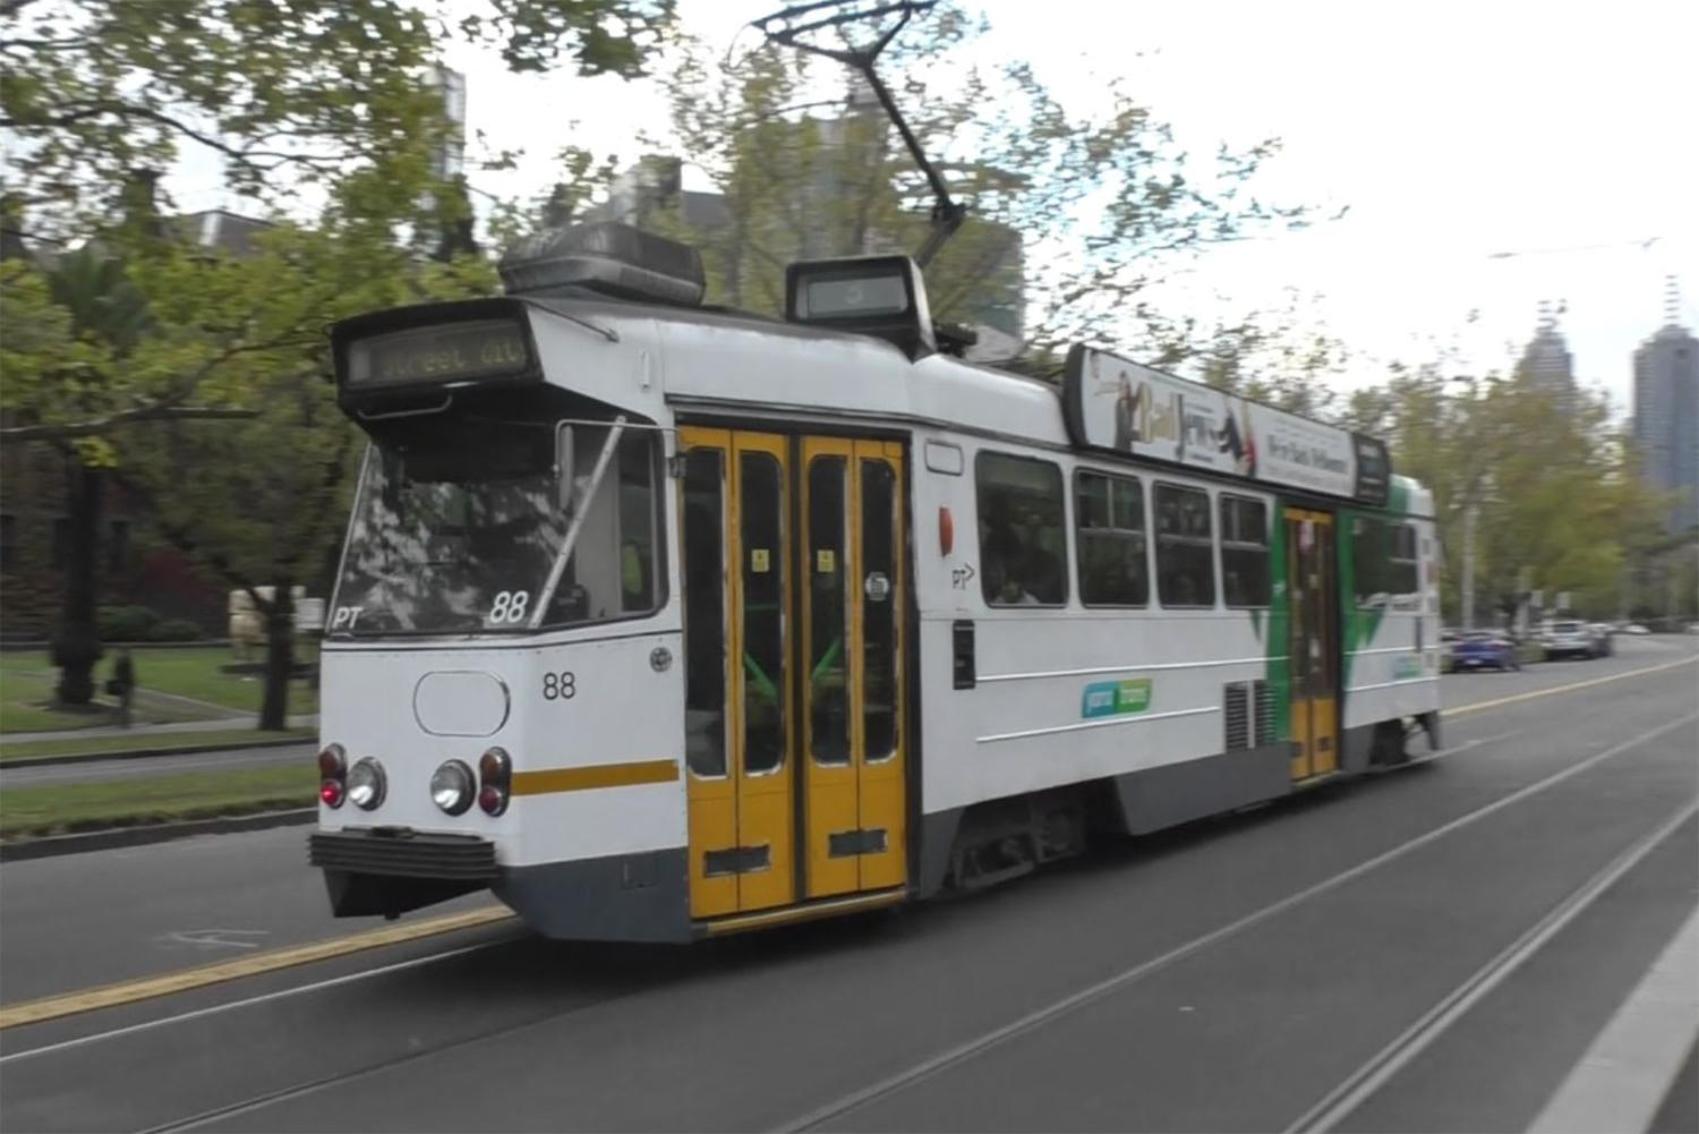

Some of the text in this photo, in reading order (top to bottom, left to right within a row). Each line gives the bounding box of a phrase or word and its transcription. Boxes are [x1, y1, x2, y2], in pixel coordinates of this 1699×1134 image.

[332, 606, 363, 629] PT
[490, 591, 529, 623] 88
[543, 672, 576, 700] 88
